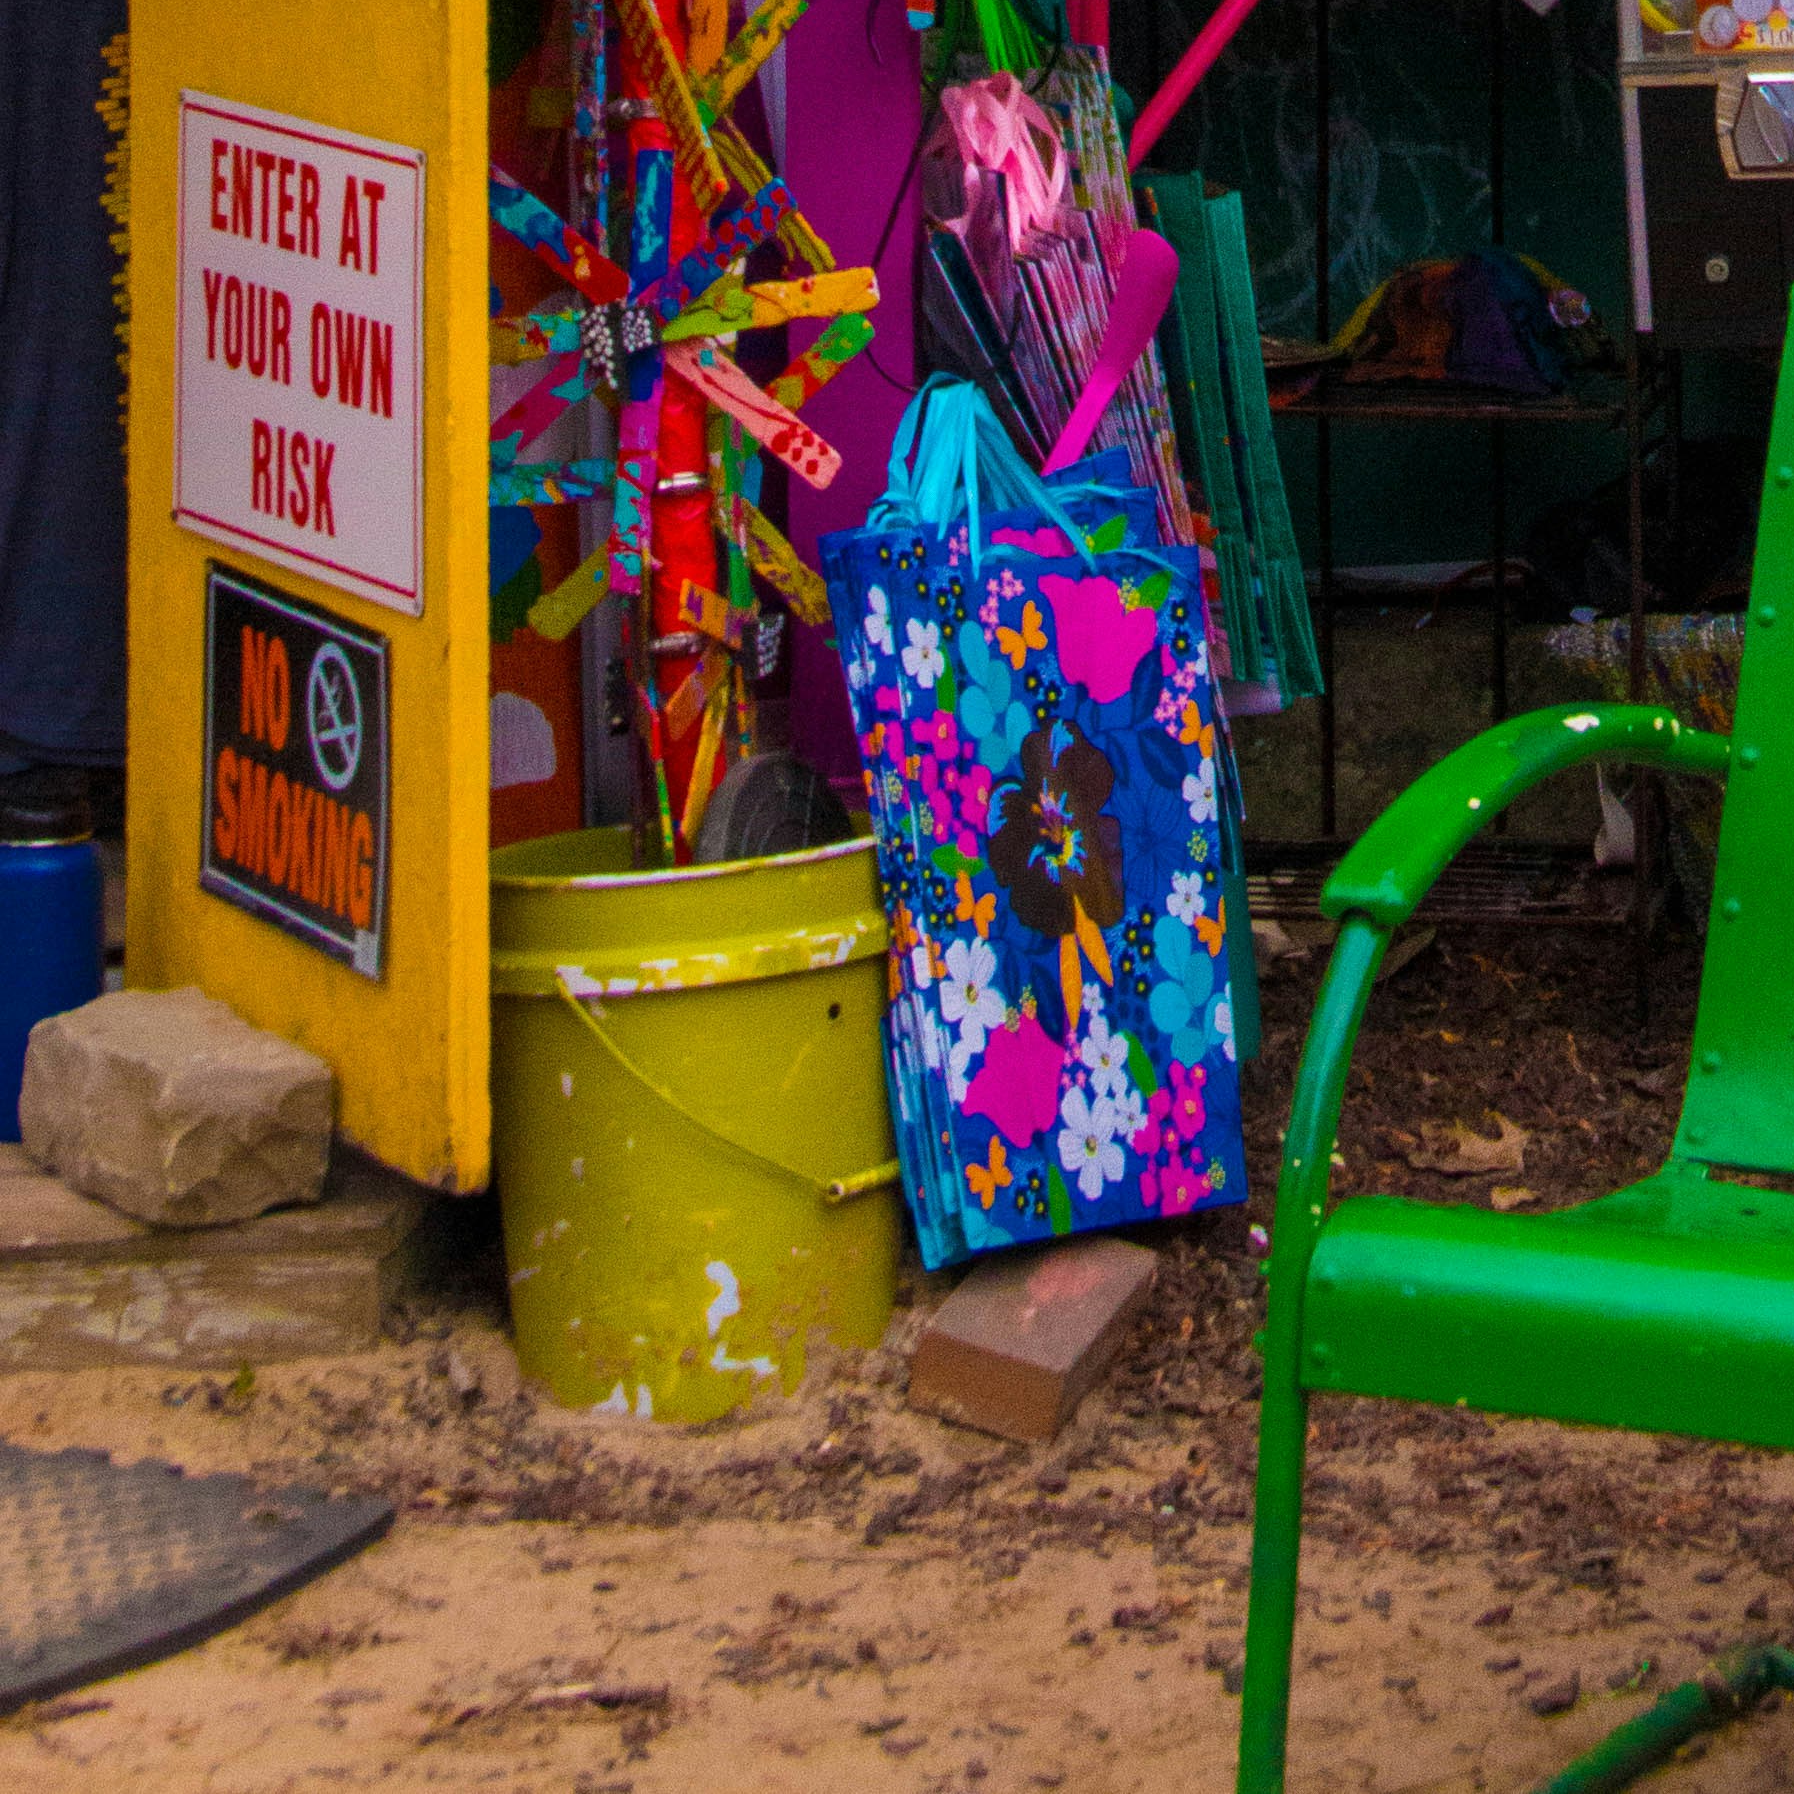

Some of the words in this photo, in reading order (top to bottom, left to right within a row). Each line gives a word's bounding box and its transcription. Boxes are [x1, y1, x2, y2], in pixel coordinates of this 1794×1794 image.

[210, 137, 321, 261] ENTER
[338, 173, 387, 277] AT
[202, 266, 292, 387] YOUR
[309, 305, 394, 420] OWN
[250, 416, 337, 538] RISK
[239, 623, 291, 754] NO
[212, 744, 373, 932] SMOKING
